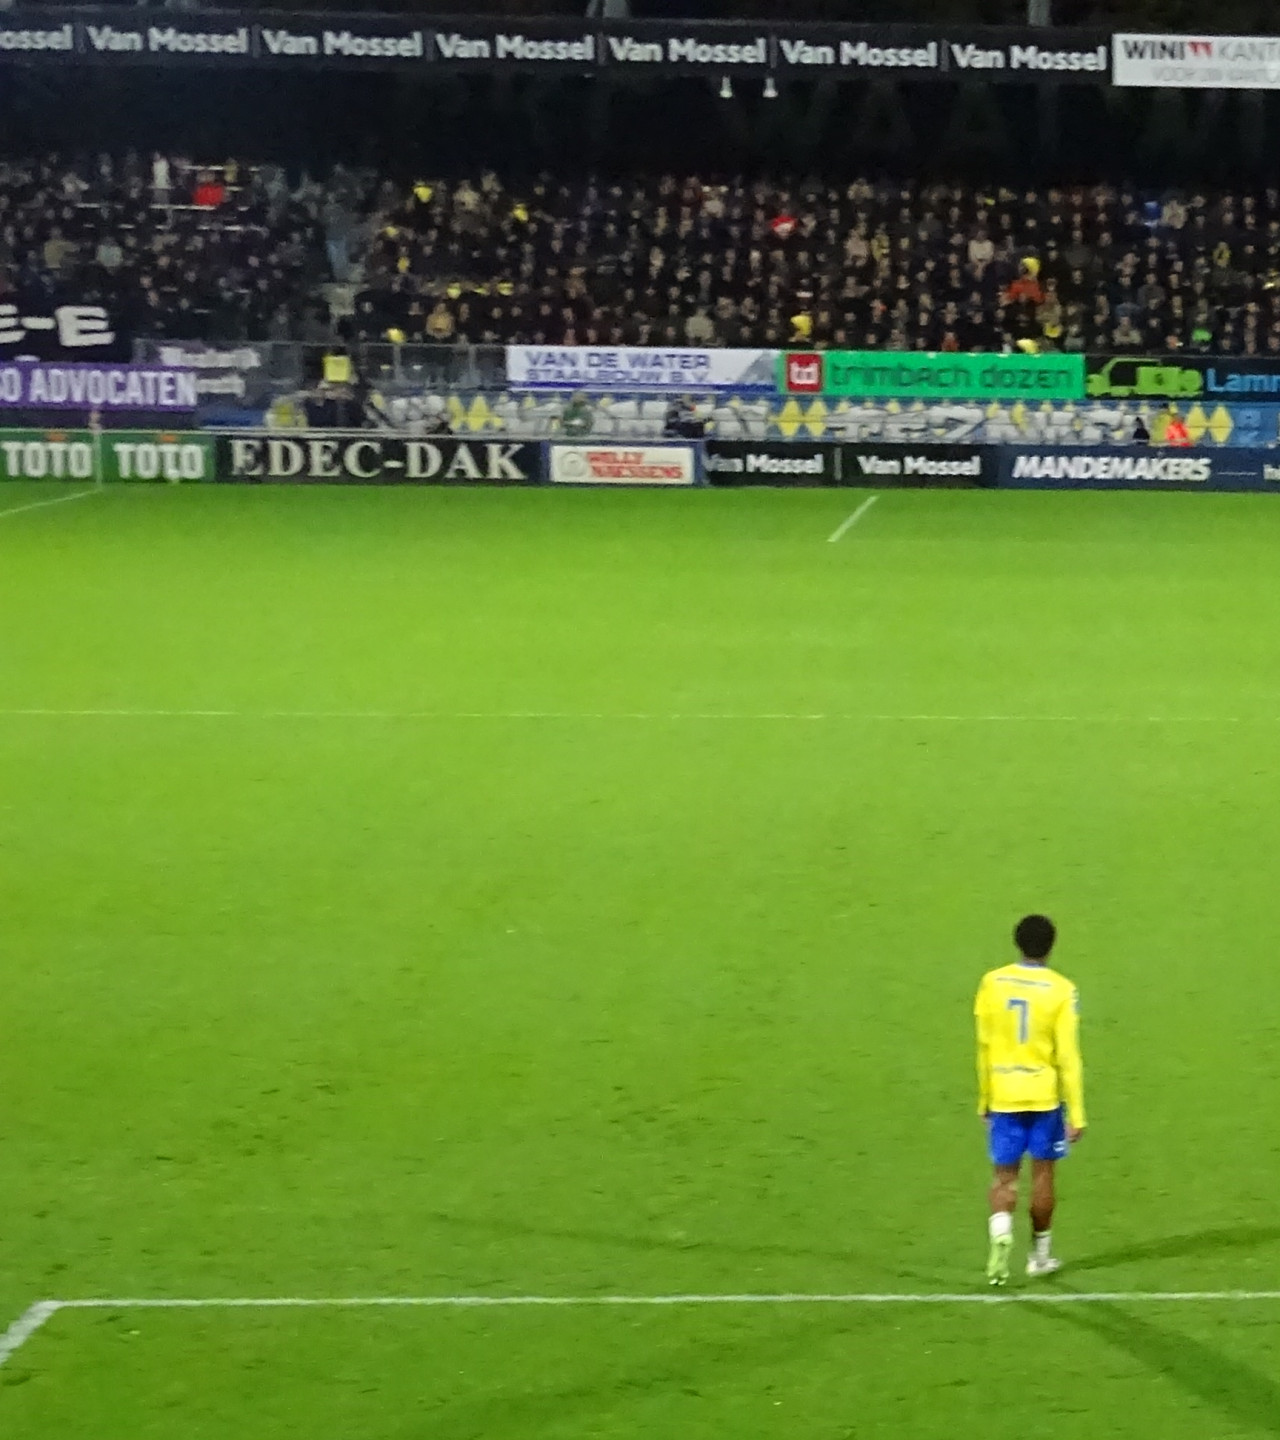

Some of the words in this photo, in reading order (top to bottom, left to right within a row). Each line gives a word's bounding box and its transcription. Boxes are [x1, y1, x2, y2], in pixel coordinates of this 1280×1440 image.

[0, 23, 74, 51] ossel
[85, 25, 143, 51] Van
[148, 27, 249, 53] Mossel
[261, 29, 318, 55] Van
[322, 30, 423, 57] Mossel
[436, 33, 491, 59] Van
[496, 34, 595, 60] Mossel
[608, 37, 662, 62] Van
[669, 38, 767, 63] Mossel
[780, 39, 835, 65] Van
[840, 41, 938, 67] Mossel
[951, 43, 1005, 69] Van
[1010, 45, 1107, 71] Mossel
[524, 351, 577, 367] VAN
[588, 353, 617, 368] DE
[626, 353, 711, 370] WATER
[30, 368, 197, 407] ADVOCATEN
[980, 363, 1073, 390] dozen
[2, 441, 93, 479] TOTO
[113, 442, 208, 480] TOTO
[229, 438, 528, 481] EDEC-DAK
[705, 454, 744, 473] Van
[746, 453, 825, 474] Mossel
[857, 455, 901, 475] Van
[903, 455, 981, 476] Mossel
[1011, 455, 1212, 482] MANDEMAKERS
[1007, 998, 1029, 1044] 7
